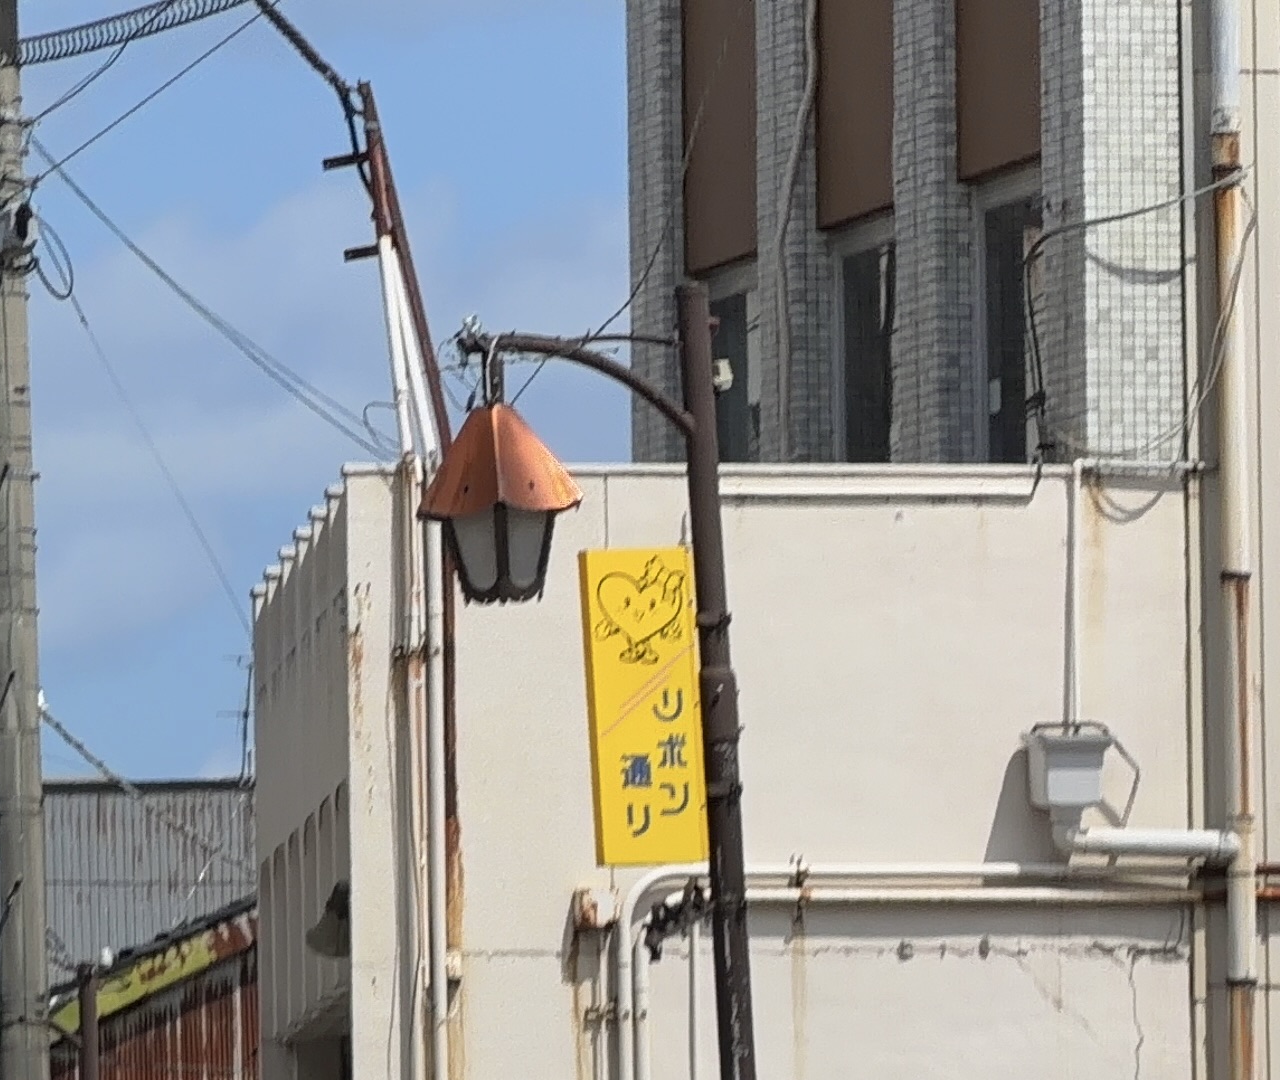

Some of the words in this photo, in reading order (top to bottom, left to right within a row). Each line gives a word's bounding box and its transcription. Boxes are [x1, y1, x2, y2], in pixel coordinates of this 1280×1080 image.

[619, 752, 653, 838] 通り
[652, 687, 690, 816] リボン
